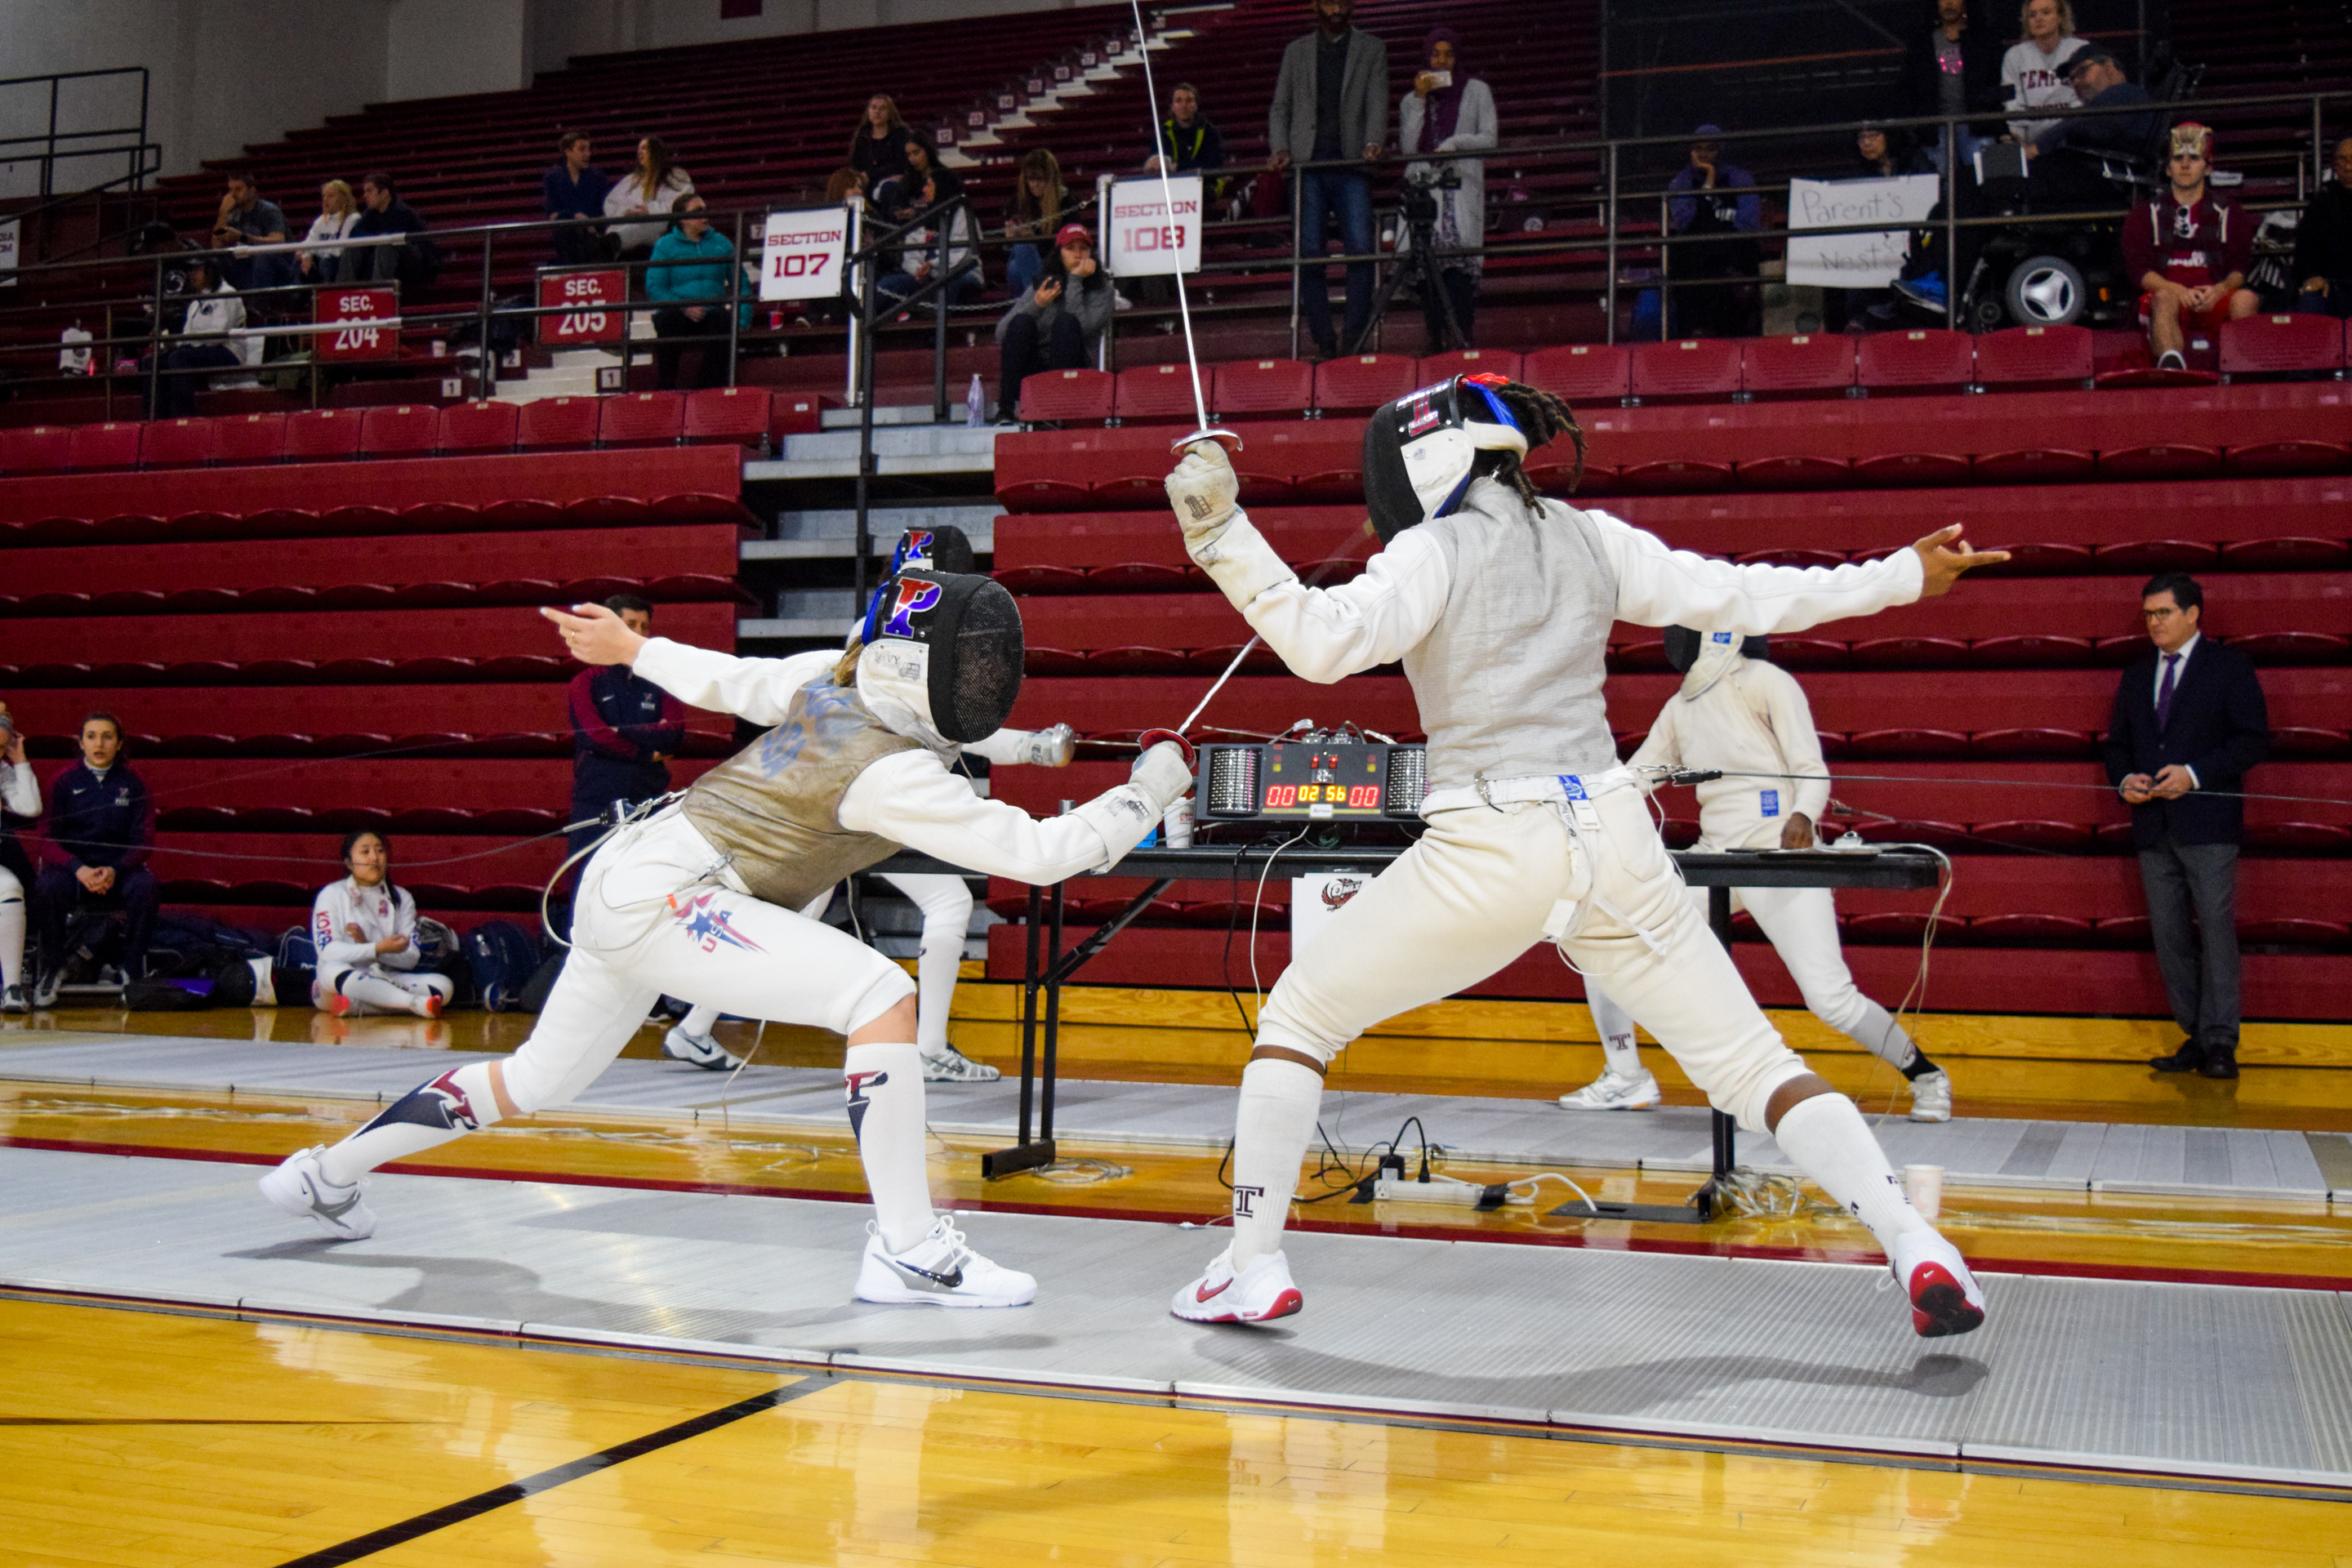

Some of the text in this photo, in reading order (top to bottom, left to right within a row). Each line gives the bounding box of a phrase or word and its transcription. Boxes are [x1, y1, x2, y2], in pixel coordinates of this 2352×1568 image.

[1114, 200, 1197, 219] SECTION
[1802, 189, 1904, 224] Parent's
[768, 229, 842, 247] SECTION
[1123, 225, 1185, 252] 108
[774, 252, 831, 278] 107
[565, 278, 603, 296] SEC.
[339, 295, 374, 313] SEC.
[559, 299, 608, 335] 205
[335, 315, 380, 350] 204
[883, 577, 942, 639] P
[1266, 785, 1297, 808] 00
[1348, 786, 1380, 808] 00
[701, 909, 733, 954] USA
